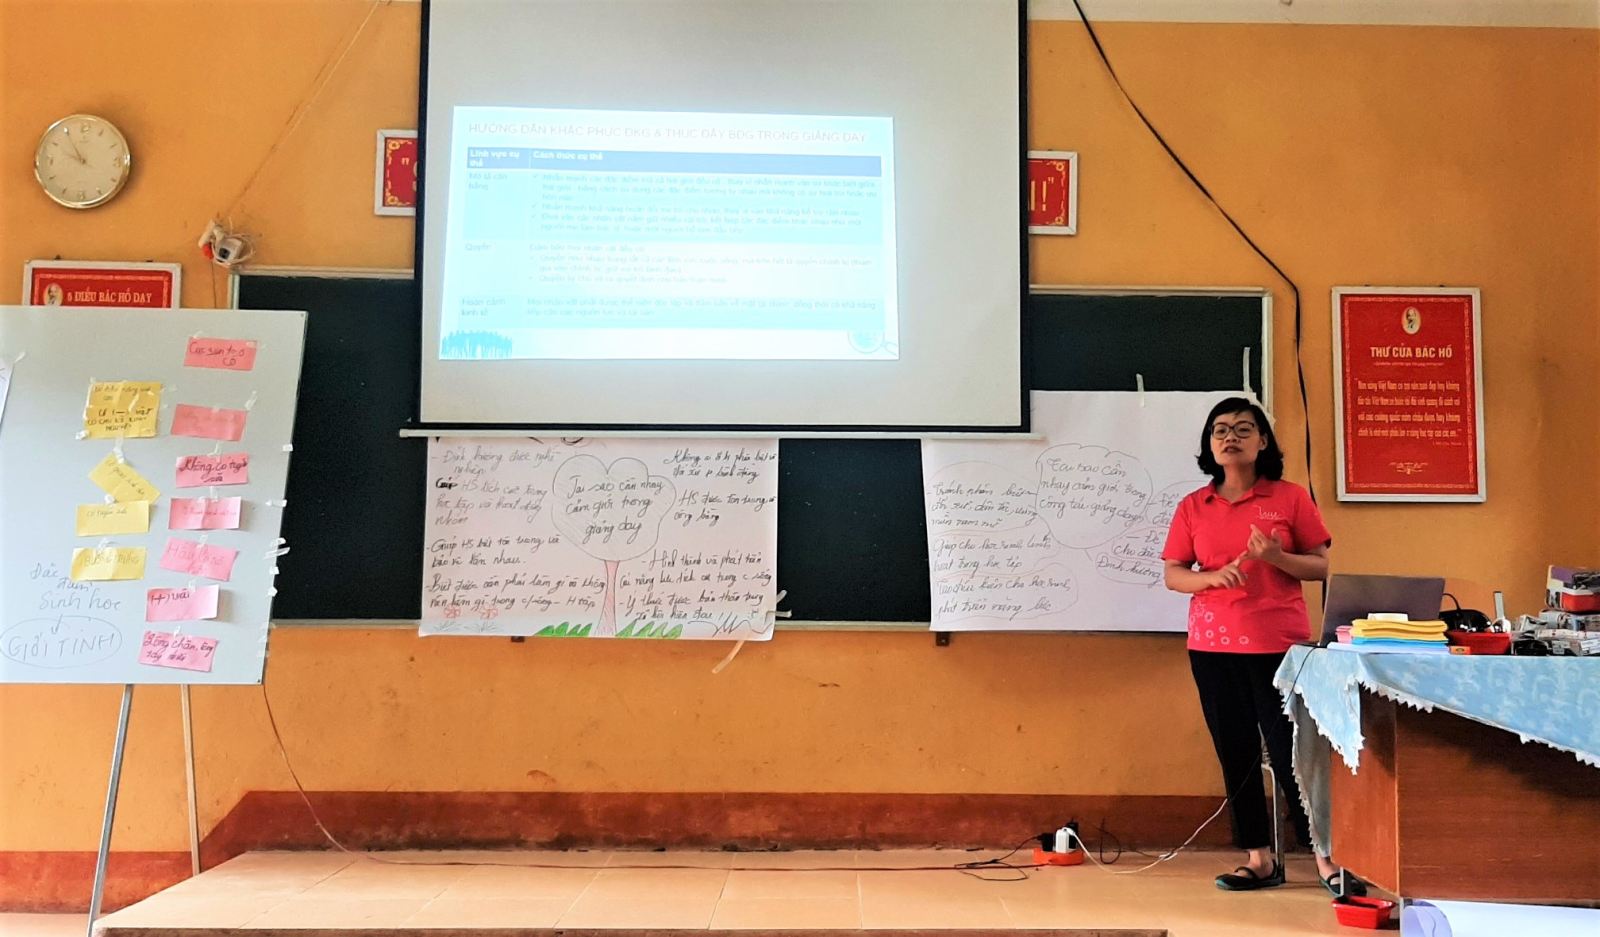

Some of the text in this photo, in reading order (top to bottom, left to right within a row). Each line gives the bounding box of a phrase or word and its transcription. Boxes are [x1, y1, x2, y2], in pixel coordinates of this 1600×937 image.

[1370, 345, 1391, 358] THƯ
[1392, 342, 1413, 358] CỦA
[1415, 345, 1436, 358] BÁC
[622, 496, 652, 518] trong
[679, 489, 700, 507] HS
[461, 538, 475, 549] HS
[721, 550, 743, 569] phát
